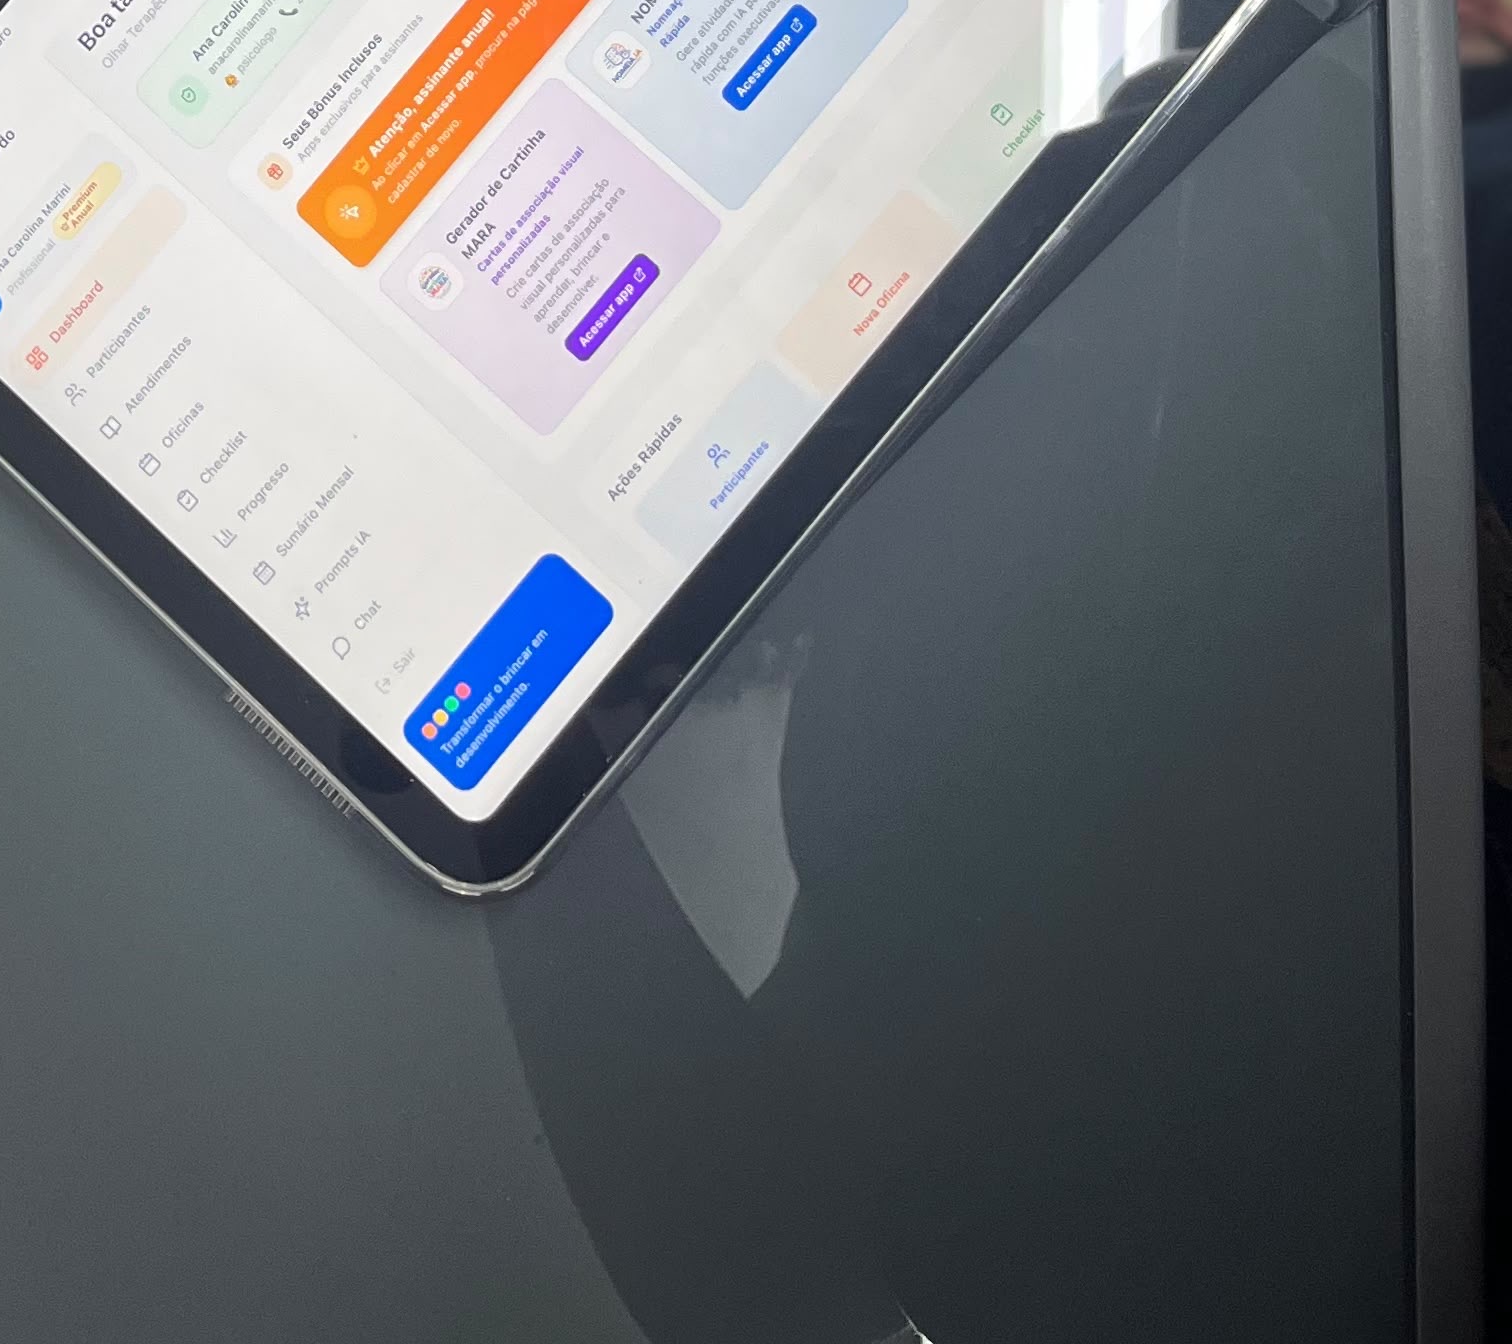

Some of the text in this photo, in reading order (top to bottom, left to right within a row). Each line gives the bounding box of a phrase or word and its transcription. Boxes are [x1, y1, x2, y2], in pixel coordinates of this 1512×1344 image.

[77, 13, 117, 52] Boa
[101, 37, 130, 69] Olhar
[192, 37, 215, 62] Ana
[659, 14, 691, 48] Rápida
[675, 37, 700, 62] Gere
[690, 41, 719, 75] rápida
[716, 19, 738, 43] com
[733, 7, 748, 21] IA
[282, 33, 383, 150] Seus Bônus Inclusos
[297, 14, 424, 163] Apps exclusivos para assinantes
[368, 7, 495, 159] Atenção, assinante anual!
[701, 45, 739, 86] funções
[736, 33, 792, 98] Acessar app
[371, 175, 386, 191] Ao
[384, 146, 409, 176] clicar
[407, 131, 424, 150] em
[420, 89, 457, 133] Acessar
[506, 15, 521, 31] na
[1001, 108, 1046, 158] Checklist
[61, 181, 98, 221] Premium
[387, 157, 427, 204] cadastrar
[425, 143, 440, 159] de
[445, 129, 546, 245] Gerador de Cartinha
[7, 216, 45, 258] Carolina
[40, 183, 72, 217] Marini
[70, 200, 95, 229] Anual
[460, 222, 497, 260] MARA
[476, 145, 585, 272] Cartas de associação visual
[505, 178, 610, 299] Crie cartas de associação
[6, 237, 57, 296] Profissional
[490, 214, 551, 286] personalizadas
[519, 187, 626, 310] visual personalizadas para
[569, 239, 603, 277] brincar
[48, 279, 104, 344] Dashboard
[579, 283, 635, 348] Acessar app
[852, 271, 911, 337] Nova Oficina
[85, 304, 151, 379] Participantes
[125, 336, 192, 415] Atendimentos
[161, 401, 205, 449] Oficinas
[199, 430, 248, 485] Checklist
[607, 414, 683, 502] Ações Rápidas
[709, 441, 770, 510] Participantes
[236, 462, 290, 522] Progresso
[275, 464, 355, 558] Sumário Mensal
[313, 530, 372, 595] Prompts IA
[353, 599, 382, 630] Chat
[392, 647, 416, 675] Sair
[439, 629, 549, 755] Transformar brincar em
